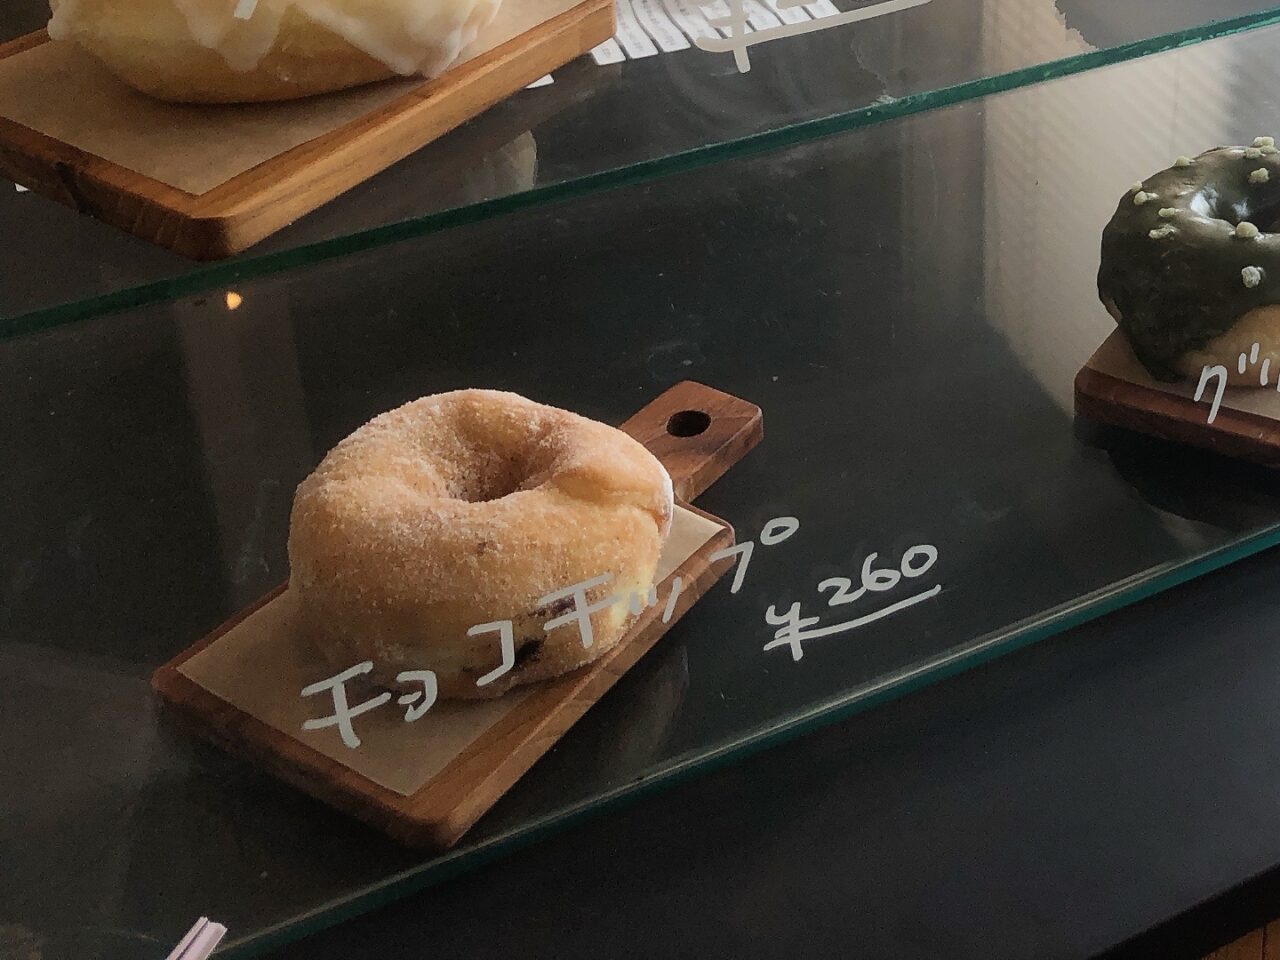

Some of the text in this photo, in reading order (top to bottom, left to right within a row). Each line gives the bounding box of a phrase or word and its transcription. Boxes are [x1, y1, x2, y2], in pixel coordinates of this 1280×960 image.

[301, 516, 800, 750] チョコチップ
[764, 544, 940, 662] ¥260
